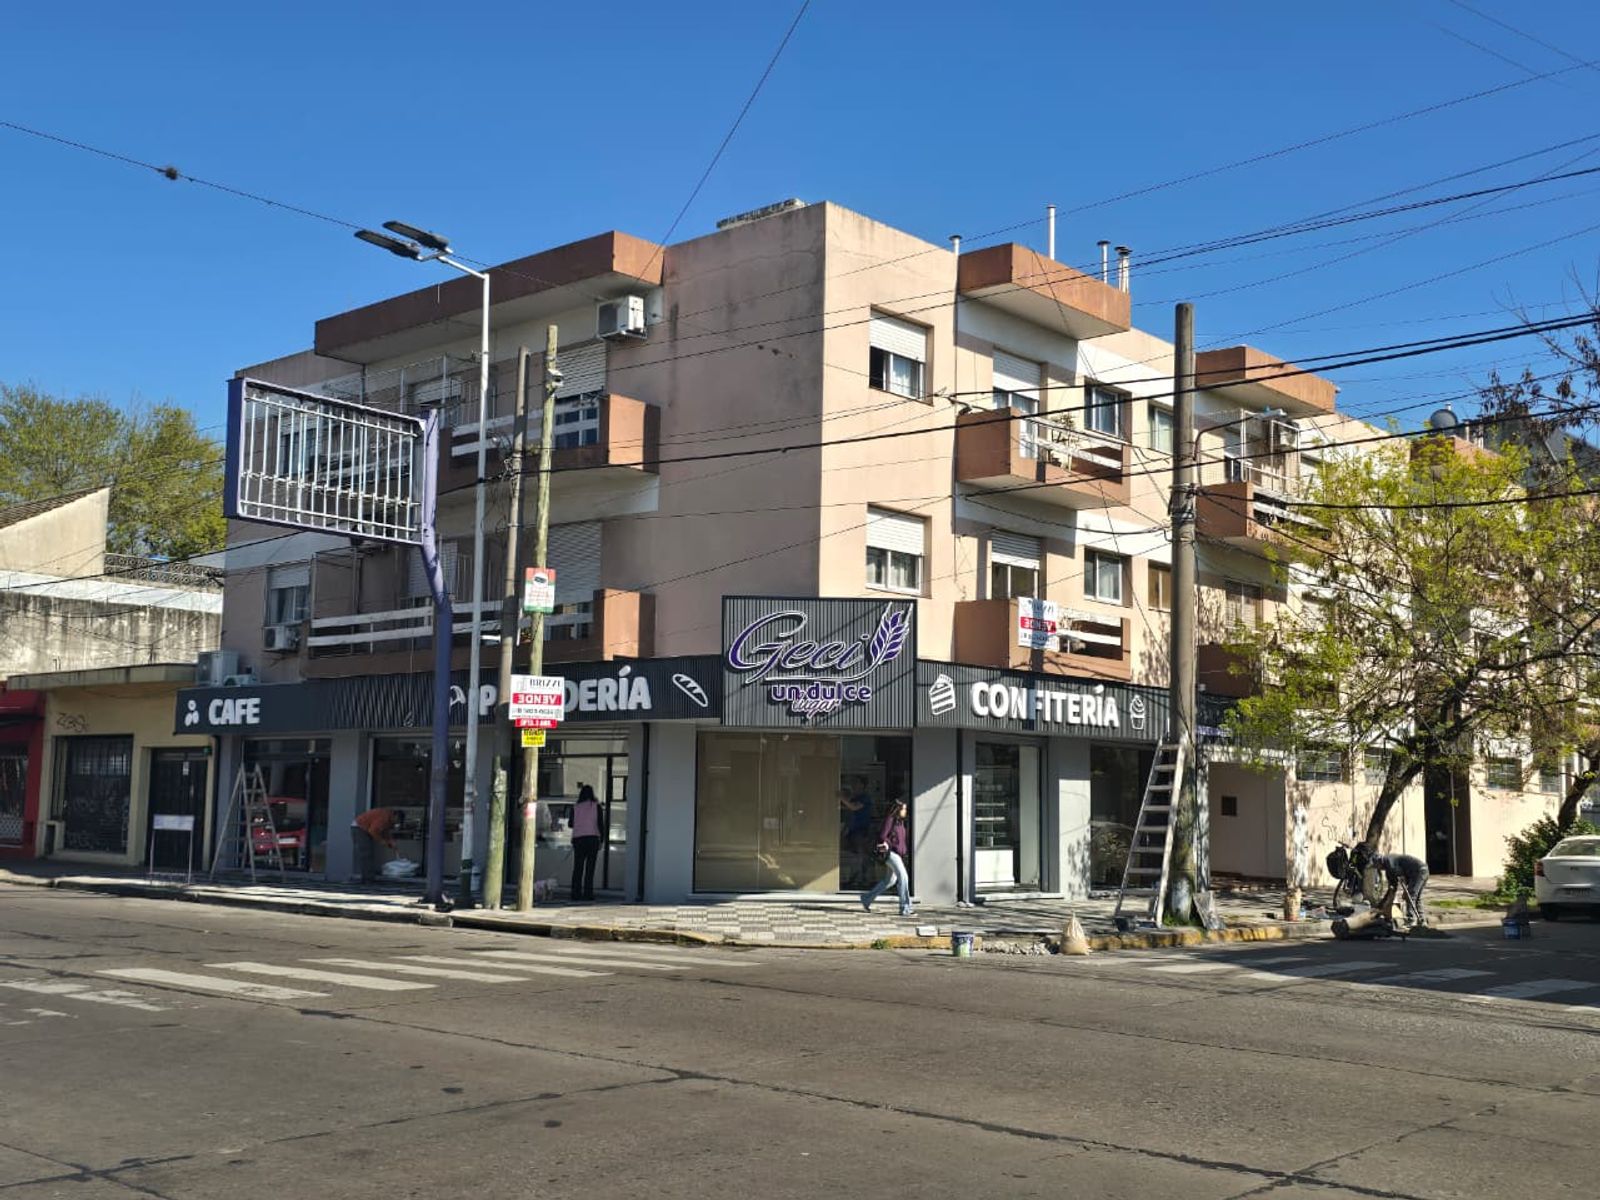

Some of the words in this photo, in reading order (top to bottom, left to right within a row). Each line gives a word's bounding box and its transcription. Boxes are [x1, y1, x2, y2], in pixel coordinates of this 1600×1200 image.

[728, 609, 870, 685] Geci
[772, 684, 801, 701] un
[807, 681, 872, 702] dulce
[971, 681, 1120, 728] CONFITERÍA
[208, 697, 261, 726] CAFE
